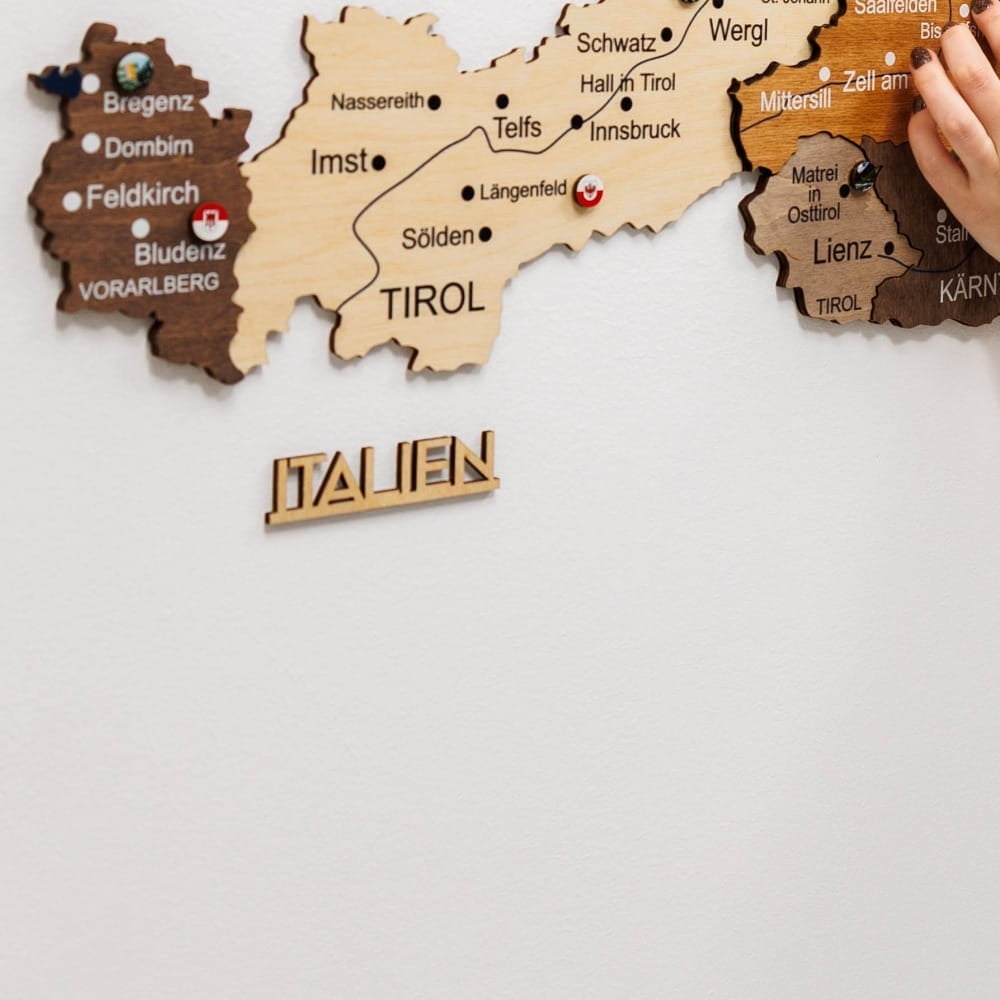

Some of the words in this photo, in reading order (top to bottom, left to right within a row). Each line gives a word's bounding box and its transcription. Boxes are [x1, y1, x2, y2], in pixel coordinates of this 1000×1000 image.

[577, 31, 657, 53] Schwatz
[709, 17, 768, 47] Wergl
[581, 73, 614, 93] Hall
[617, 74, 634, 92] in
[640, 73, 676, 92] Tirol
[843, 69, 876, 93] Zell
[881, 72, 909, 91] am
[103, 91, 195, 118] Bregenz
[331, 93, 425, 111] Nassereith
[760, 88, 831, 112] Mittersill
[492, 115, 542, 139] Telfs
[590, 119, 681, 142] Innsbruck
[104, 135, 194, 159] Dornbirn
[311, 147, 368, 176] Imst
[792, 163, 839, 185] Matrei
[87, 180, 200, 209] Feldkirch
[480, 179, 567, 203] Längenfeld
[808, 185, 821, 201] in
[788, 202, 841, 224] Osttirol
[402, 226, 474, 250] Sölden
[134, 241, 226, 267] Bludenz
[814, 238, 873, 265] Lienz
[79, 271, 220, 301] VORARLBERG
[379, 280, 486, 320] TIROL
[816, 293, 862, 316] TIROL
[266, 430, 498, 524] ITALIEN
